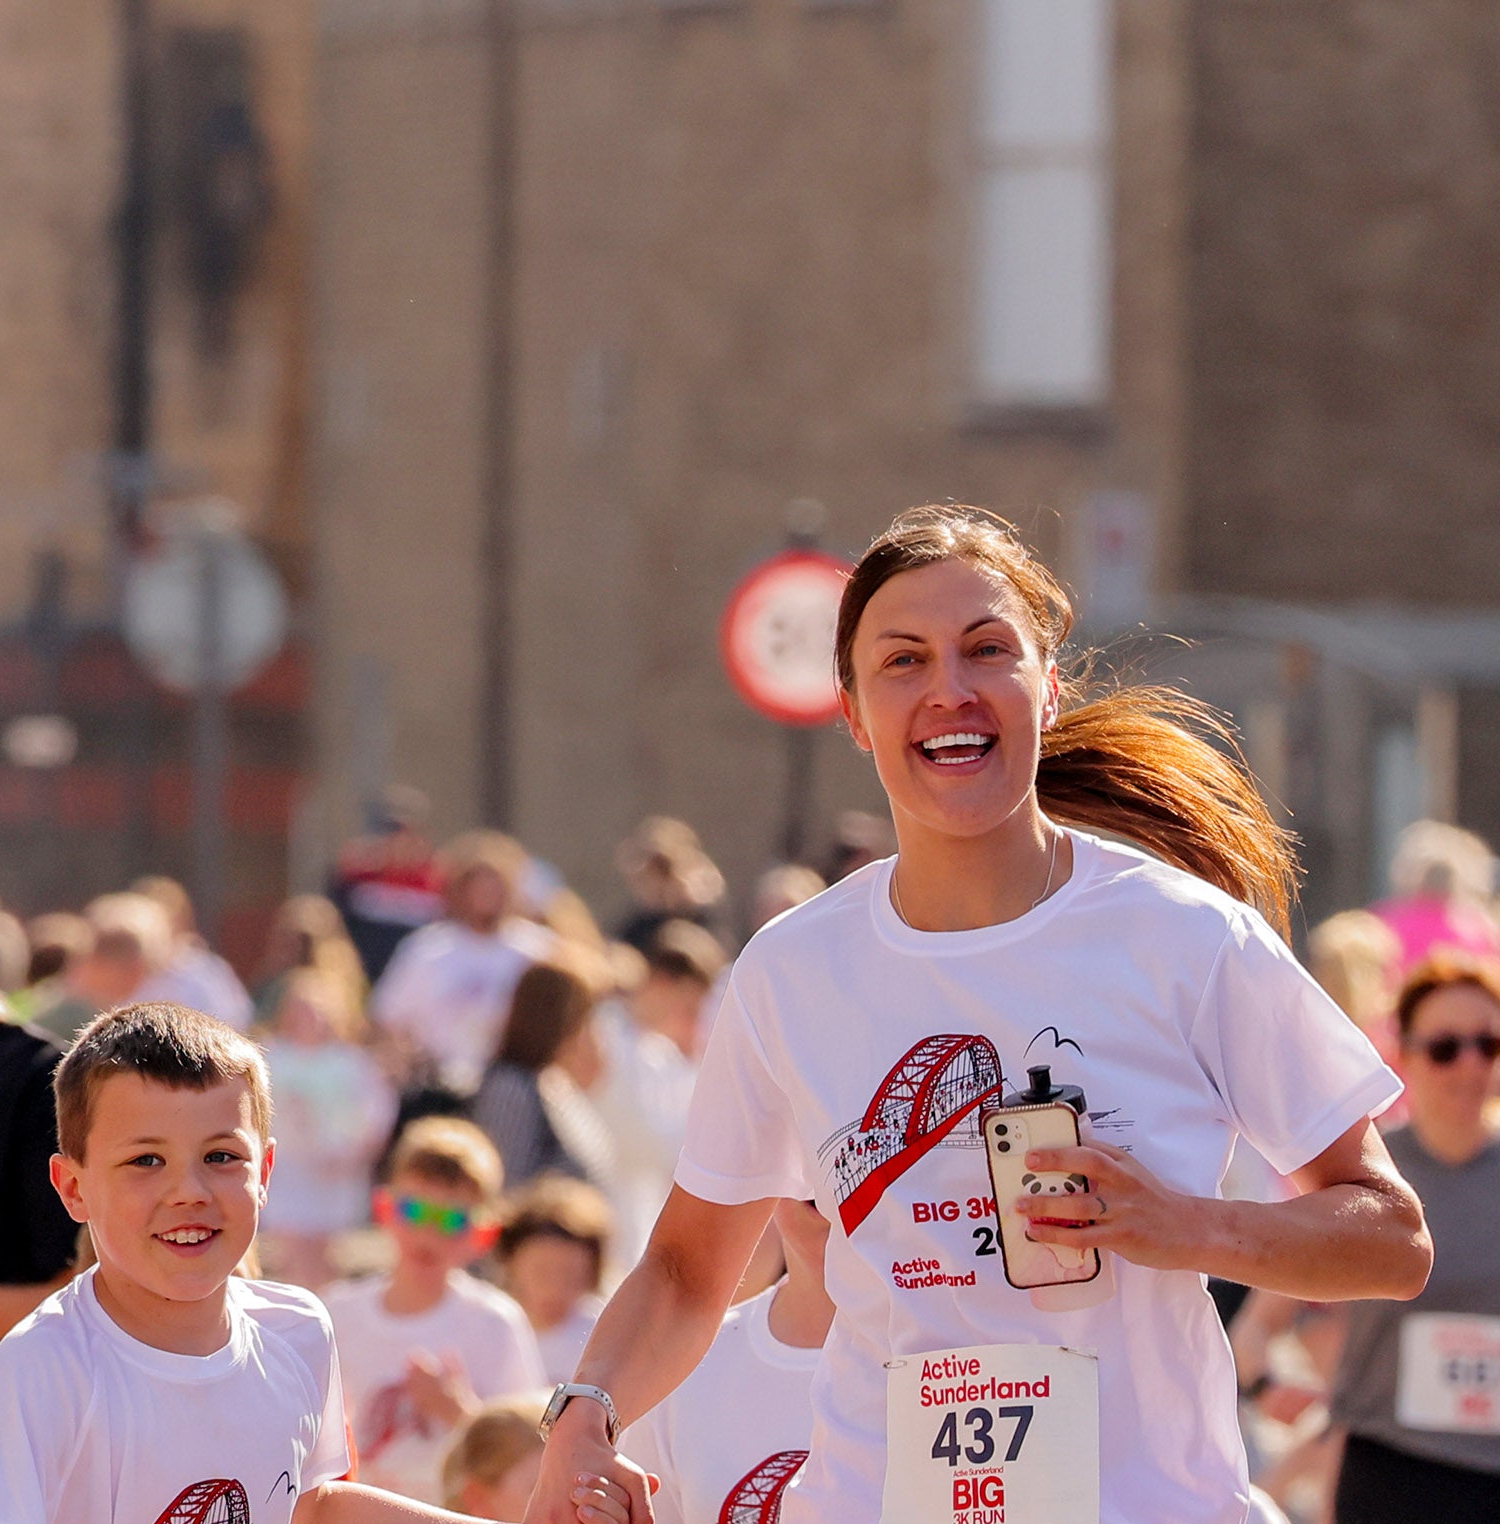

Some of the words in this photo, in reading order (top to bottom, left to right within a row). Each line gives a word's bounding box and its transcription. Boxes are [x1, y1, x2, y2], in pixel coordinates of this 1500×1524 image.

[912, 1201, 960, 1223] BIG
[966, 1197, 997, 1219] 3K
[892, 1257, 940, 1274] Active
[920, 1354, 980, 1381] Active
[920, 1375, 1050, 1407] Sunderland
[931, 1405, 1034, 1467] 437
[953, 1469, 969, 1478] Active
[969, 1466, 1004, 1477] Sunderland
[953, 1476, 1004, 1511] BIG
